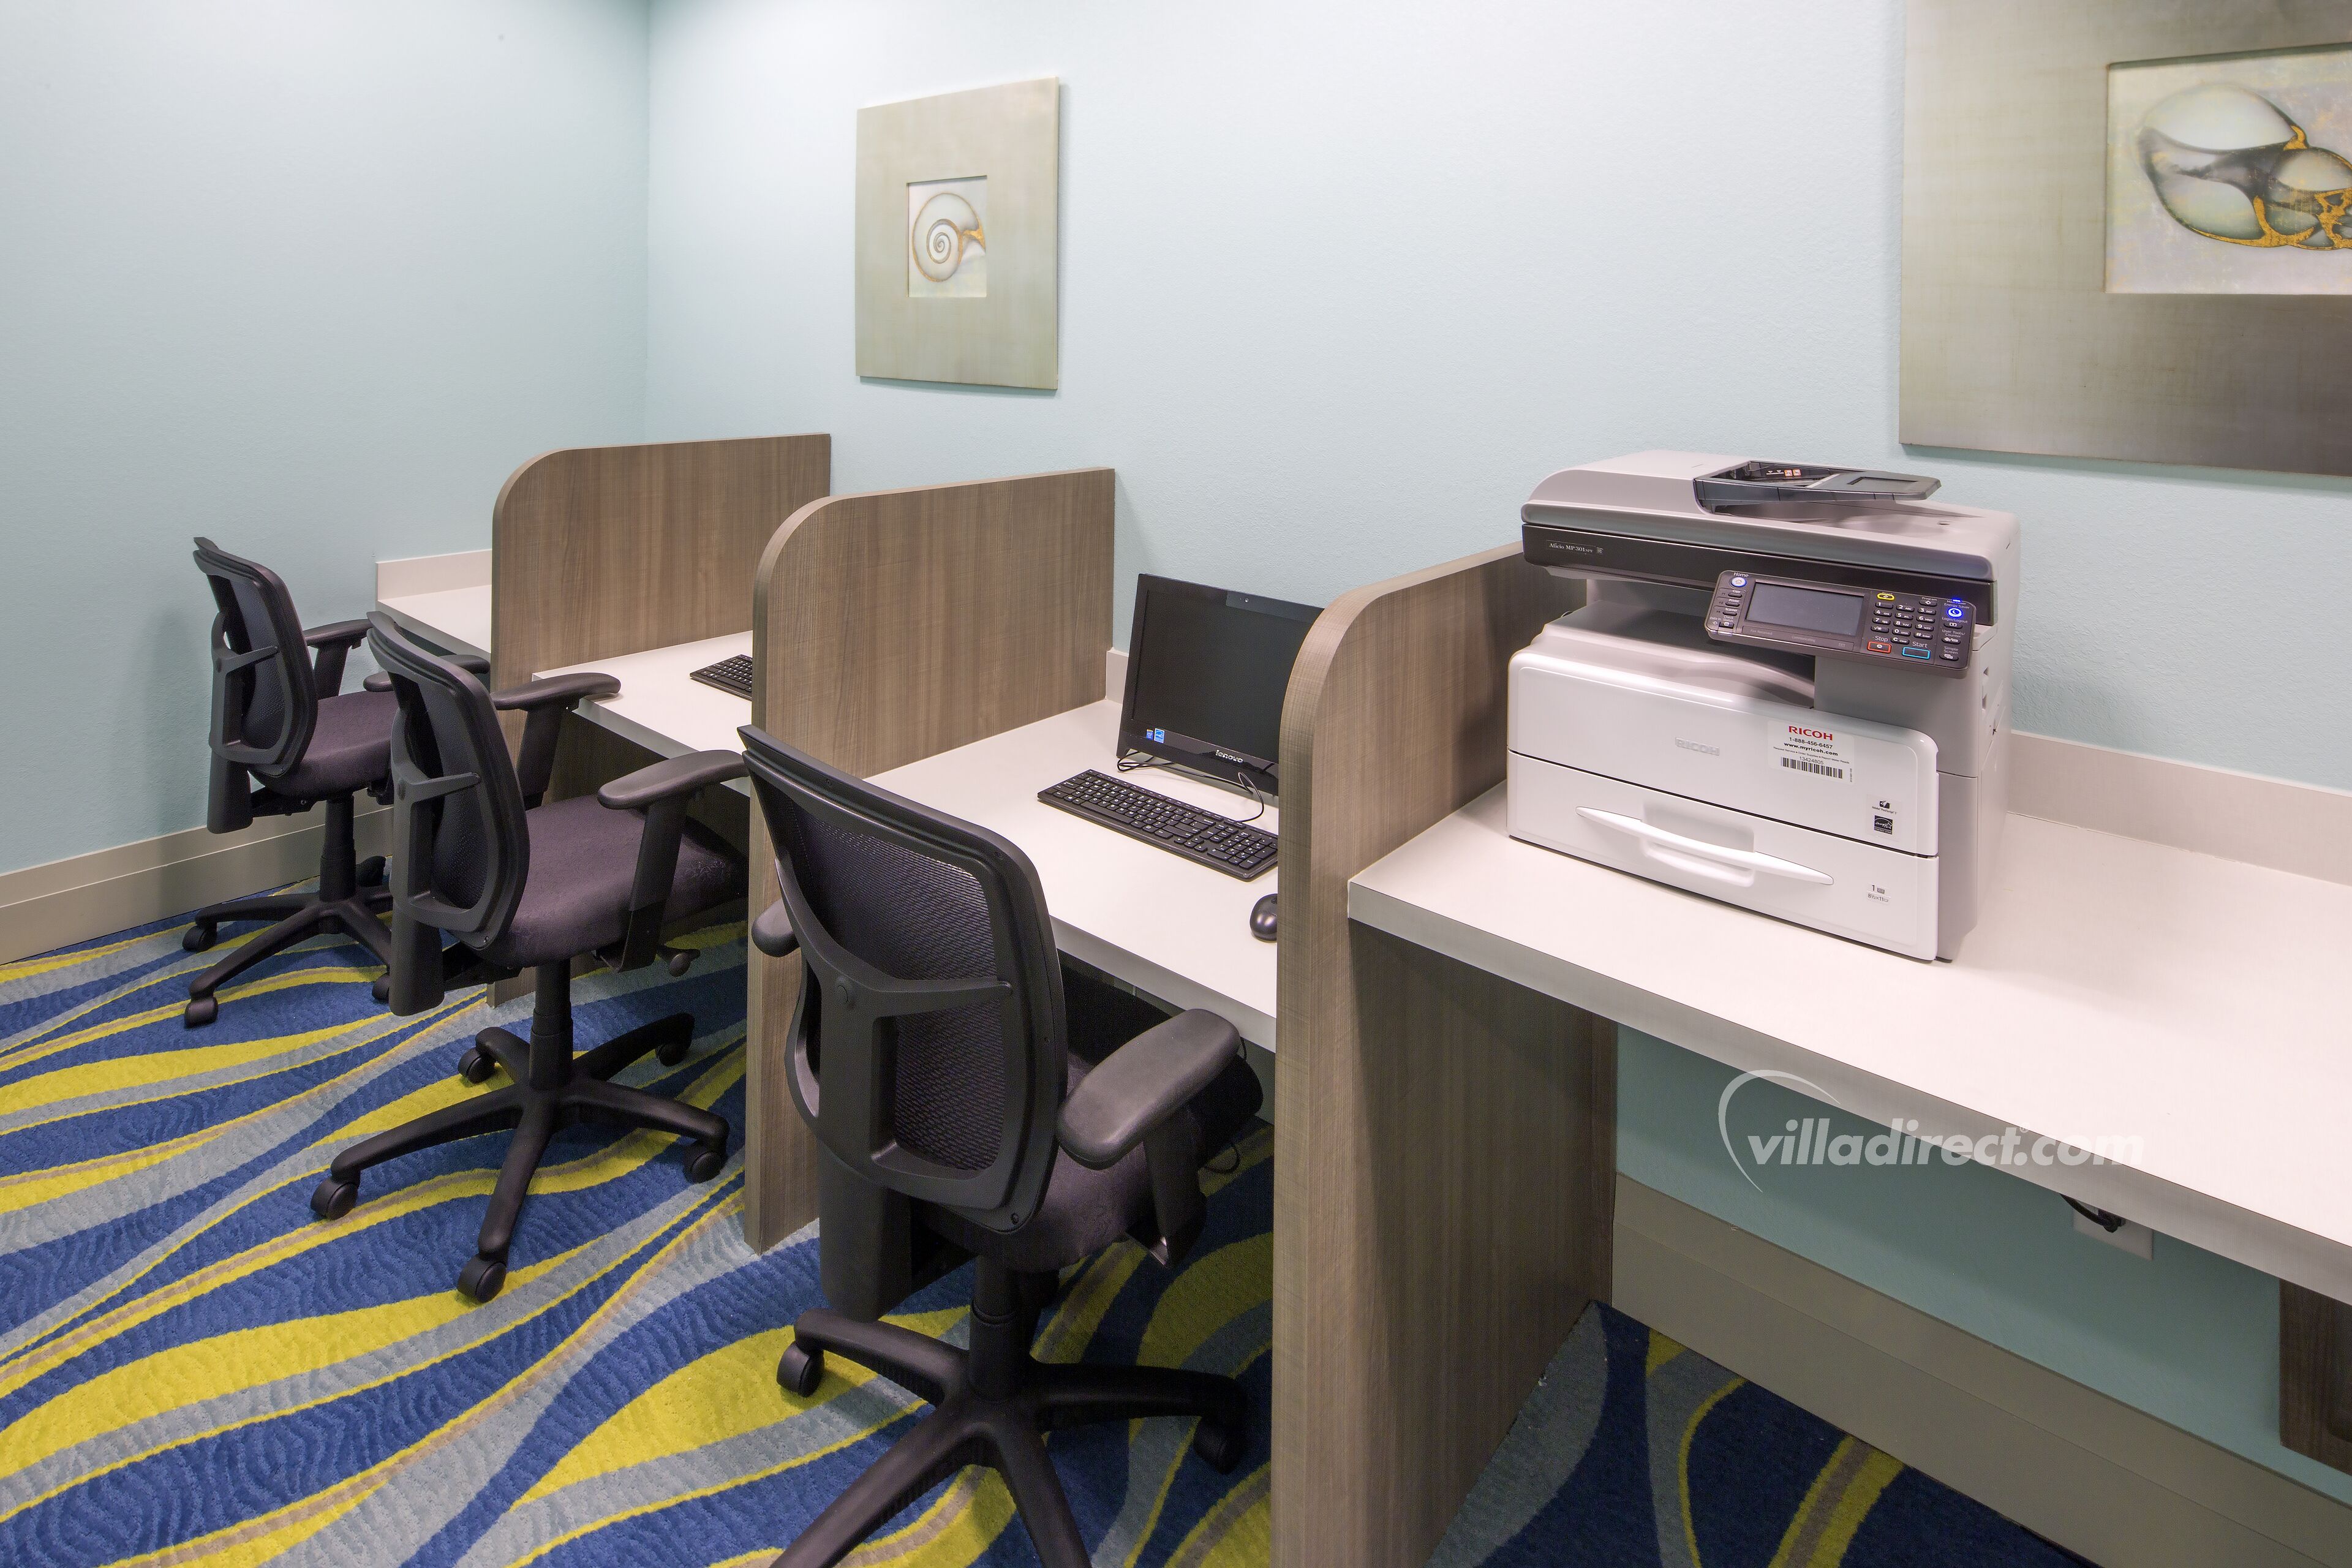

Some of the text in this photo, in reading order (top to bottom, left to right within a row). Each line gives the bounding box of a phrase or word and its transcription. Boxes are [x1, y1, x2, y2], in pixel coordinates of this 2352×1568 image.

[1789, 726, 1833, 741] RICOH
[1784, 742, 1838, 756] www.myricoh.com
[1789, 737, 1833, 749] 1-888-456-6457
[1215, 749, 1243, 763] lenovo
[1800, 756, 1824, 765] 13424805
